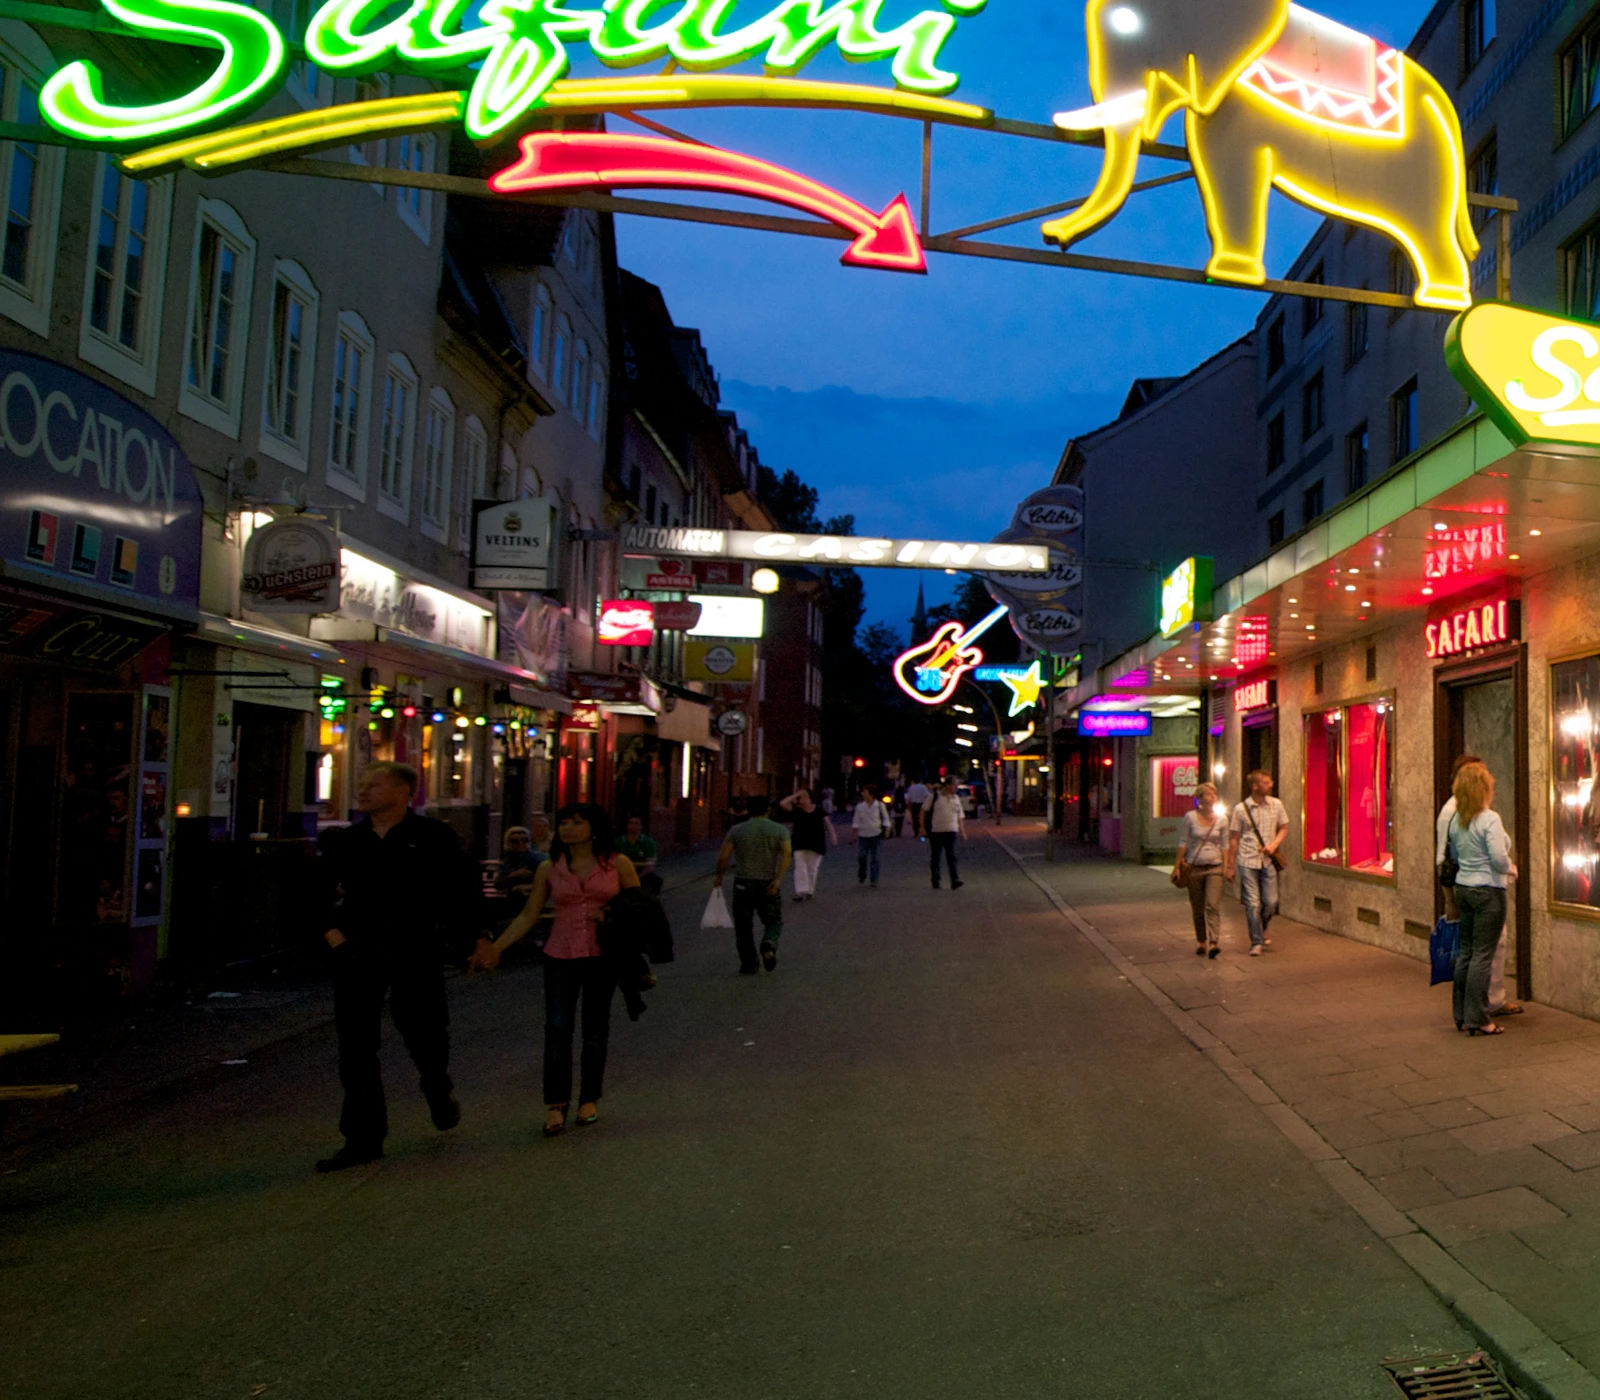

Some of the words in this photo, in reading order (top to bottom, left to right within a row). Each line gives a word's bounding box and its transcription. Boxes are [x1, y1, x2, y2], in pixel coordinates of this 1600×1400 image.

[0, 371, 176, 512] OCATION
[1028, 507, 1077, 524] Colibri
[485, 535, 540, 547] VELTINS
[626, 527, 725, 553] AUTOMATEN
[752, 533, 1026, 568] CASINO
[649, 575, 690, 586] ASTRA
[1025, 613, 1075, 630] Colibri
[1425, 600, 1508, 659] SAFARI
[1234, 680, 1267, 712] SAFARI
[1082, 714, 1149, 731] CASINO
